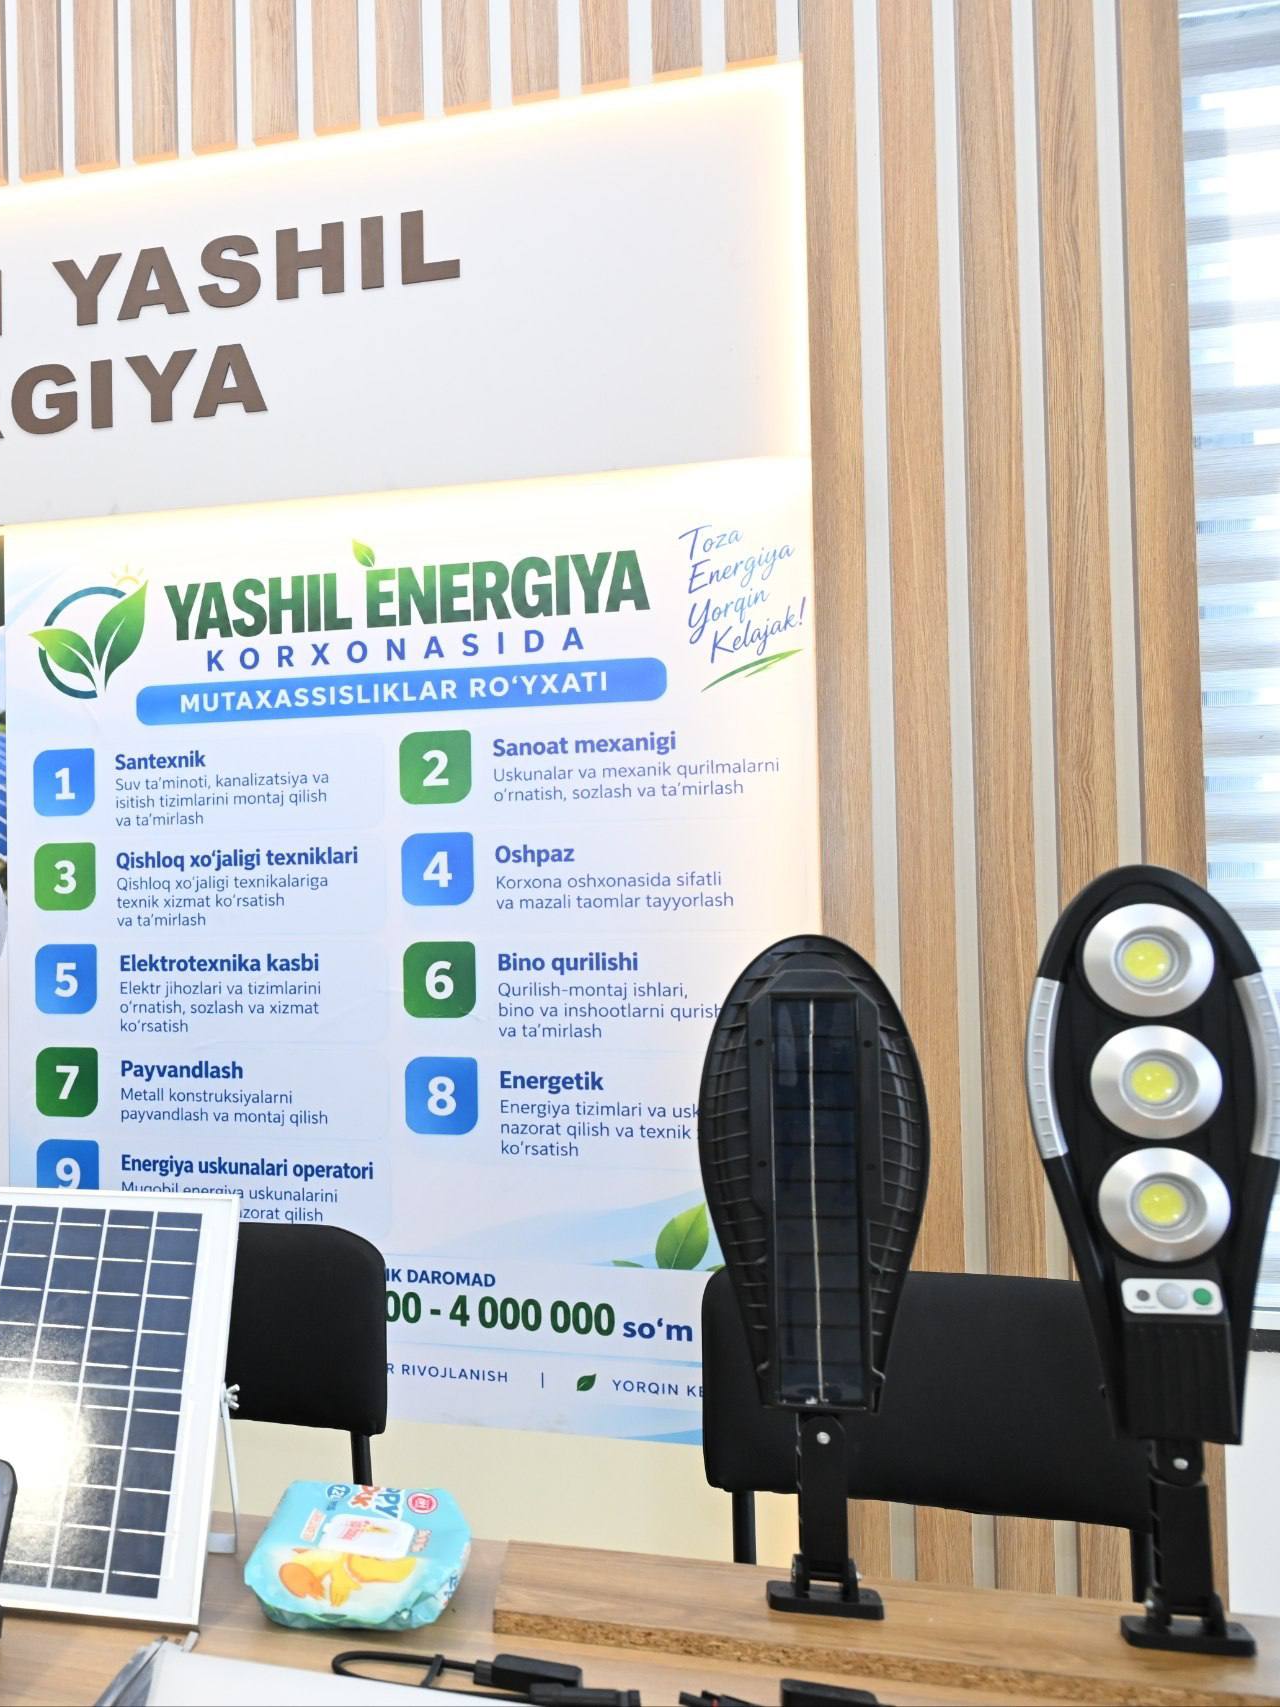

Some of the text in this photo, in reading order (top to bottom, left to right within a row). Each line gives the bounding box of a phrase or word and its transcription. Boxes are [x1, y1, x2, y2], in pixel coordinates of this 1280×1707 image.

[52, 210, 461, 326] YASHIL
[678, 524, 743, 560] Toza
[688, 544, 795, 594] Energiya
[164, 549, 651, 641] YASHIL ENERGIYA
[688, 587, 770, 645] Yorqin
[710, 596, 807, 664] Kelajak!
[207, 627, 584, 672] KORXONASIDA
[180, 681, 457, 713] MUTAXASSISLIKLAR
[492, 731, 677, 757] Sanoat mexanigi
[115, 750, 206, 771] Santexnik
[421, 749, 450, 788] 2
[494, 757, 780, 783] Uskunalar va mexanik qurilmalarni
[54, 767, 76, 801] 1
[116, 778, 141, 791] Suv
[216, 772, 308, 788] kanalizatsiya
[313, 774, 329, 785] va
[572, 783, 632, 800] sozlash
[637, 786, 656, 798] va
[116, 788, 327, 809] isitish tizimlarini montaj qilish
[116, 816, 131, 827] va
[116, 850, 184, 872] Qishloq
[266, 846, 358, 866] texniklari
[495, 845, 575, 867] Oshpaz
[53, 859, 77, 895] 3
[422, 850, 453, 888] 4
[117, 875, 171, 892] Qishloq
[234, 872, 328, 890] texnikalariga
[496, 871, 722, 890] Korxona oshxonasida sifatli
[117, 894, 159, 908] texnik
[164, 893, 211, 907] xizmat
[496, 892, 734, 911] va mazali taomlar tayyorlash
[117, 916, 132, 927] va
[120, 953, 319, 972] Elektrotexnika kasbi
[498, 952, 638, 975] Bino qurilishi
[54, 962, 78, 998] 5
[120, 980, 321, 998] Elektr jihozlari va tizimlarini
[425, 960, 454, 1000] 6
[498, 981, 688, 1001] Qurilish-montaj ishlari,
[191, 1000, 243, 1014] sozlash
[248, 1004, 265, 1015] va
[270, 1001, 319, 1015] xizmat
[498, 1002, 534, 1018] bino
[540, 1006, 558, 1018] va
[564, 1002, 664, 1018] inshootlarni
[499, 1027, 517, 1038] va
[120, 1060, 244, 1082] Payvandlash
[500, 1070, 604, 1094] Energetik
[55, 1065, 79, 1100] 7
[120, 1088, 292, 1107] Metall konstruksiyalarni
[427, 1076, 457, 1117] 8
[120, 1108, 328, 1128] payvandlash va montaj qilish
[500, 1100, 570, 1118] Energiya
[576, 1101, 642, 1117] tizimlari
[648, 1106, 667, 1118] va
[501, 1121, 691, 1140] nazorat qilish va texnik
[55, 1157, 81, 1189] 9
[121, 1154, 374, 1181] Energiya uskunalari operatori
[249, 1187, 338, 1203] uskunalarini
[285, 1208, 323, 1224] qilish
[407, 1269, 496, 1287] DAROMAD
[449, 1295, 470, 1327] 4
[478, 1296, 542, 1332] 000
[550, 1300, 615, 1337] 000
[402, 1364, 508, 1383] RIVOJLANISH
[612, 1380, 679, 1397] YORQIN
